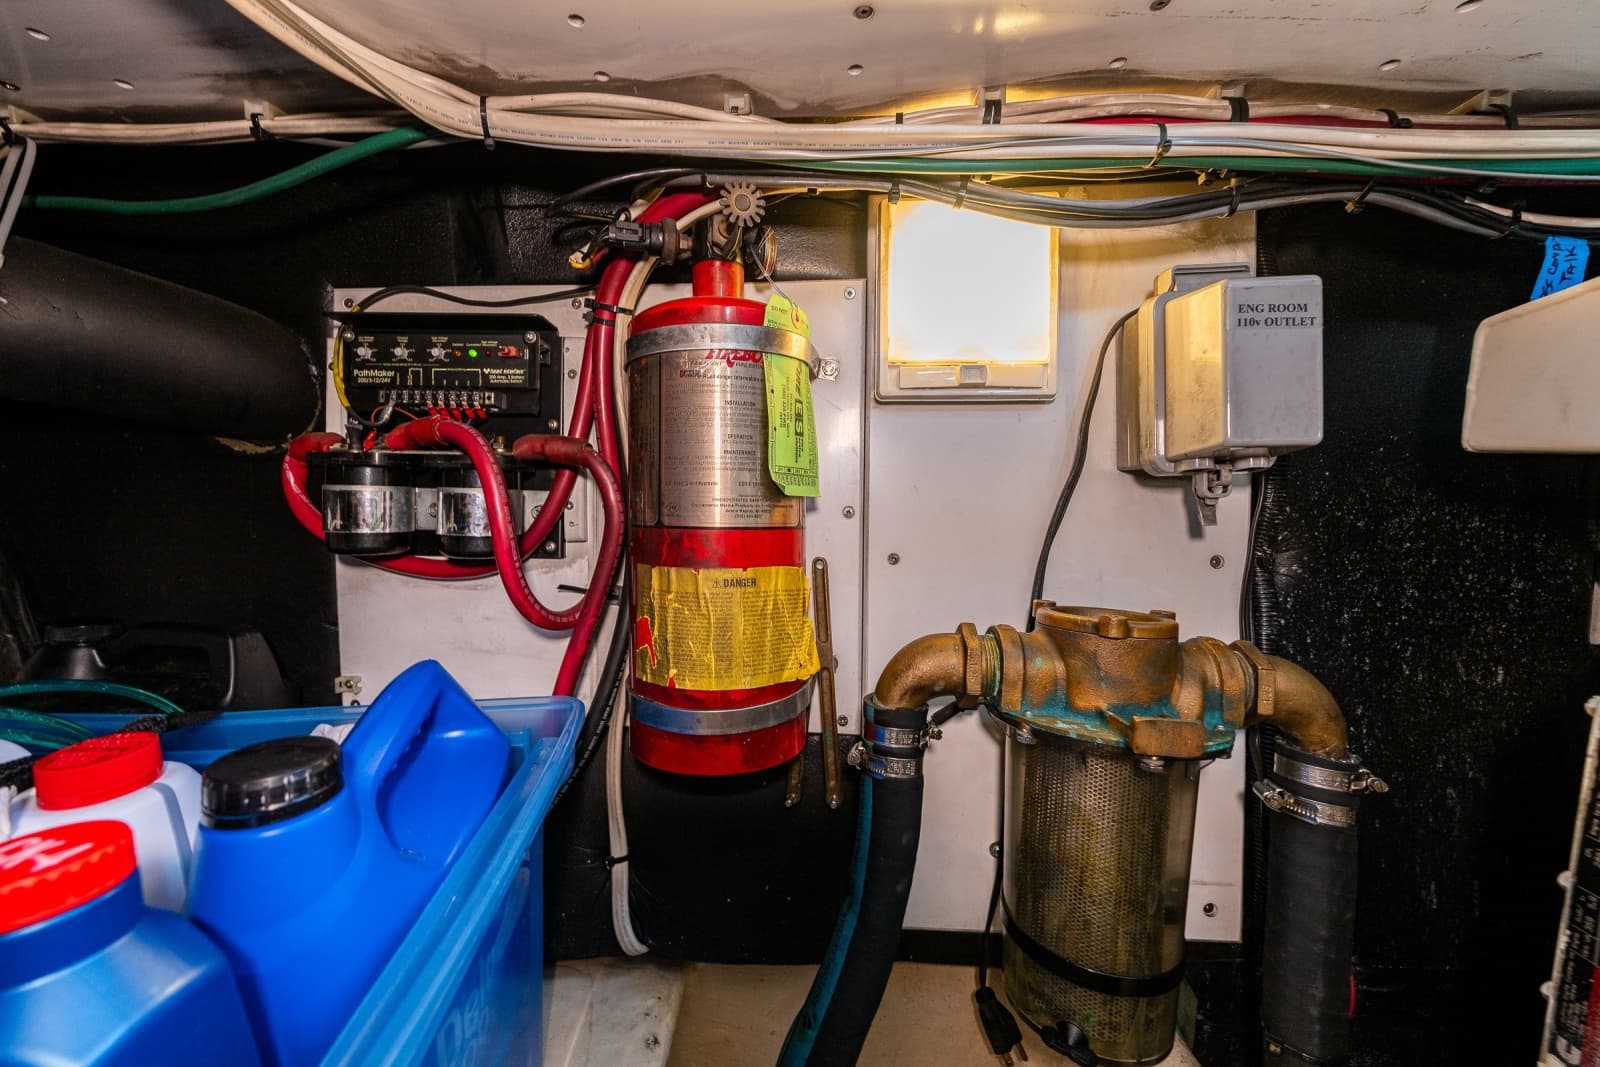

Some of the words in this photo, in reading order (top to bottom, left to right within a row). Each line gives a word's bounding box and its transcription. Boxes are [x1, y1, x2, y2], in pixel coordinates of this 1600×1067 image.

[1238, 303, 1265, 313] ENG
[1268, 303, 1308, 313] ROOM
[1237, 317, 1262, 327] 110v
[1264, 316, 1317, 327] OUTLET
[353, 369, 395, 377] PathMaker
[724, 399, 756, 407] INSTALLATION
[723, 577, 757, 588] DANGER
